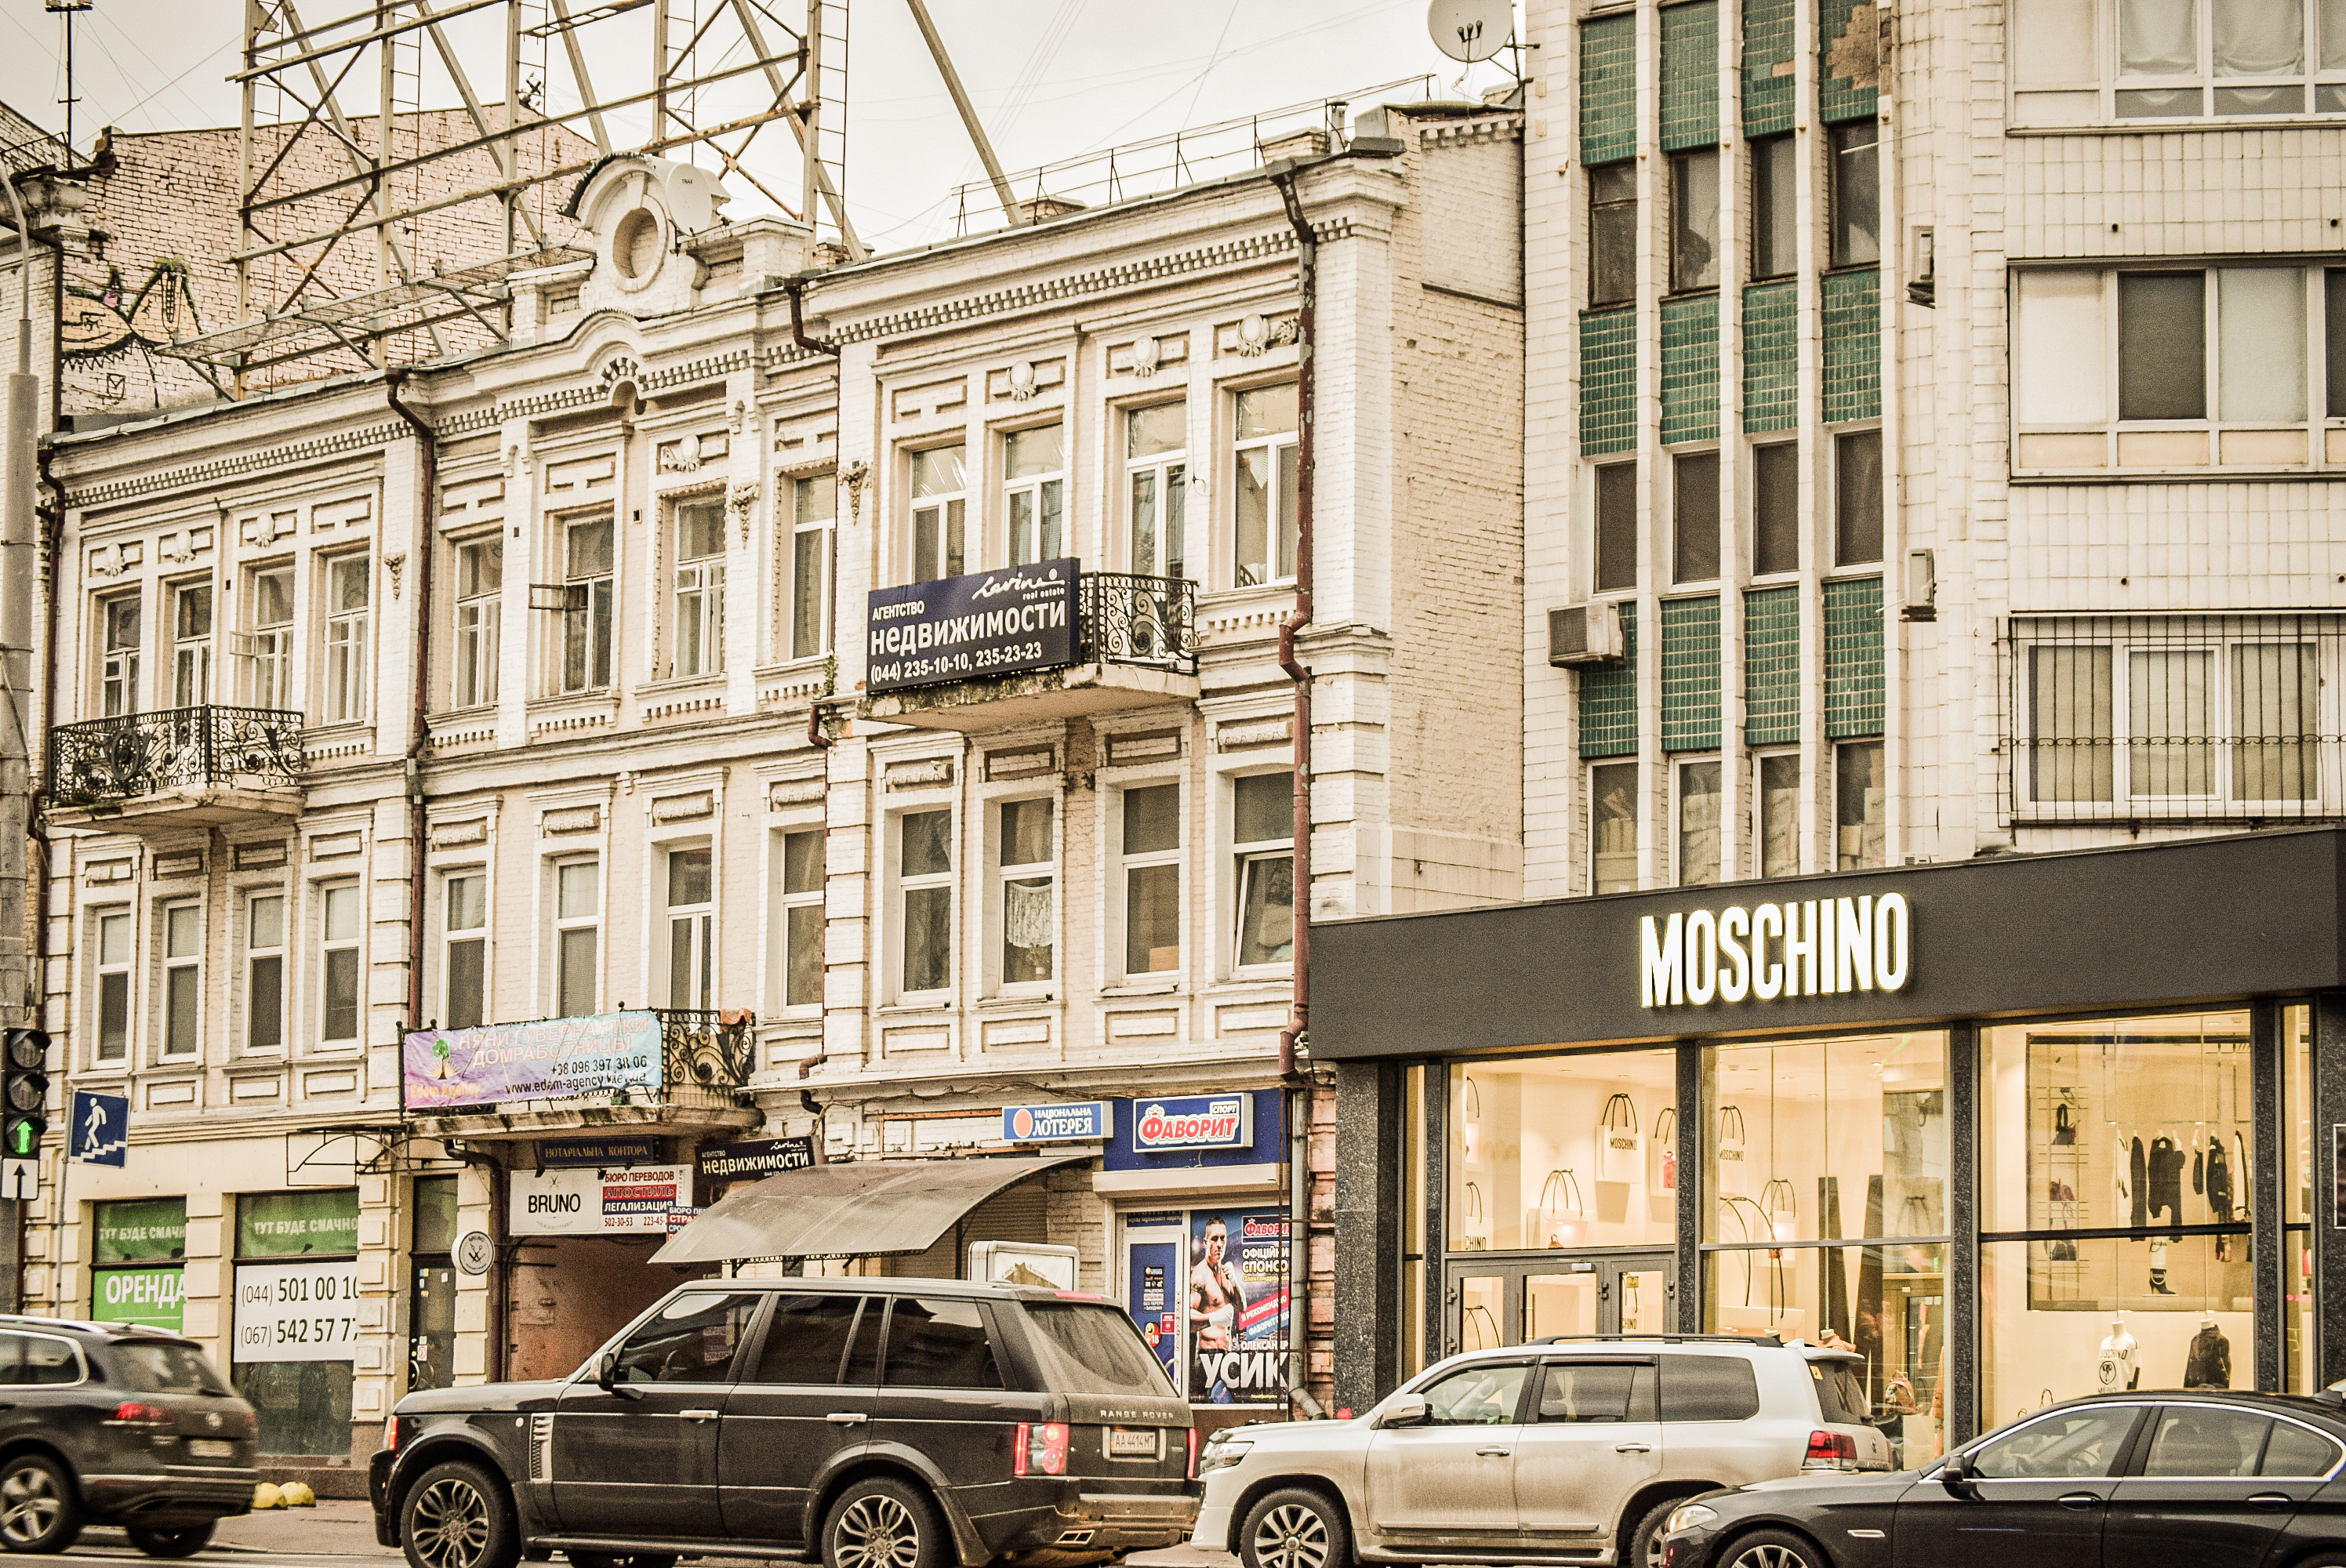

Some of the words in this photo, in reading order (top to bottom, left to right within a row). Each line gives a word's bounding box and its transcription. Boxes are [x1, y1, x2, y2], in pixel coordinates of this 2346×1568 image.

[1022, 590, 1038, 601] real
[1040, 587, 1065, 597] estate
[872, 601, 924, 621] АГЕНТСТВО
[870, 661, 901, 685] (044)
[904, 652, 972, 679] 235-10-10,
[975, 641, 1042, 667] 235-23-23
[1640, 892, 1908, 1008] MOSCHINO
[459, 1029, 509, 1051] НЯНИ
[514, 1016, 648, 1044] ГУВЕРНАНТКИ
[472, 1035, 631, 1069] ДОМРАБОТНИЦЫ
[551, 1062, 568, 1076] +38
[572, 1060, 590, 1074] 096
[593, 1058, 612, 1072] 397
[616, 1057, 630, 1069] 38
[633, 1055, 647, 1068] 06
[1034, 1107, 1092, 1119] НАЦІОНАЛЬНА
[1212, 1104, 1237, 1115] СПОРТ
[1033, 1117, 1093, 1136] ЛОТЕРЕЯ
[1142, 1116, 1236, 1140] ФАВОРИТ
[545, 1147, 604, 1158] НОТАРІАЛЬНА
[608, 1145, 648, 1156] КОНТОРА
[1610, 1137, 1637, 1151] MOSCHINO
[605, 1172, 628, 1183] БЮРО
[629, 1171, 674, 1183] ПЕРЕВОДОВ
[605, 1185, 674, 1199] АПОСТИЛЬ
[528, 1193, 581, 1213] BRUNO
[604, 1200, 674, 1212] ЛЕГАЛИЗАЦИЯ
[254, 1221, 274, 1235] ТУТ
[276, 1220, 306, 1235] БУДЕ
[310, 1217, 358, 1232] СМАЧНО
[605, 1217, 634, 1227] 502-30-53
[643, 1216, 667, 1226] 223-45-
[670, 1214, 695, 1223] СТРА
[100, 1228, 118, 1240] ТУТ
[119, 1227, 147, 1241] БУДЕ
[1465, 1236, 1487, 1251] CHINO
[1242, 1260, 1290, 1273] СПОНСО
[105, 1274, 187, 1309] ОРЕНДА
[242, 1283, 273, 1307] (044)
[278, 1277, 309, 1302] 501
[315, 1276, 336, 1301] 00
[1240, 1313, 1247, 1322] Я
[241, 1325, 272, 1348] (067)
[277, 1319, 307, 1343] 542
[314, 1318, 335, 1342] 57
[1248, 1317, 1276, 1335] ФАВОРИТ
[1199, 1352, 1288, 1388] УСИК
[1100, 1410, 1137, 1418] RANGE
